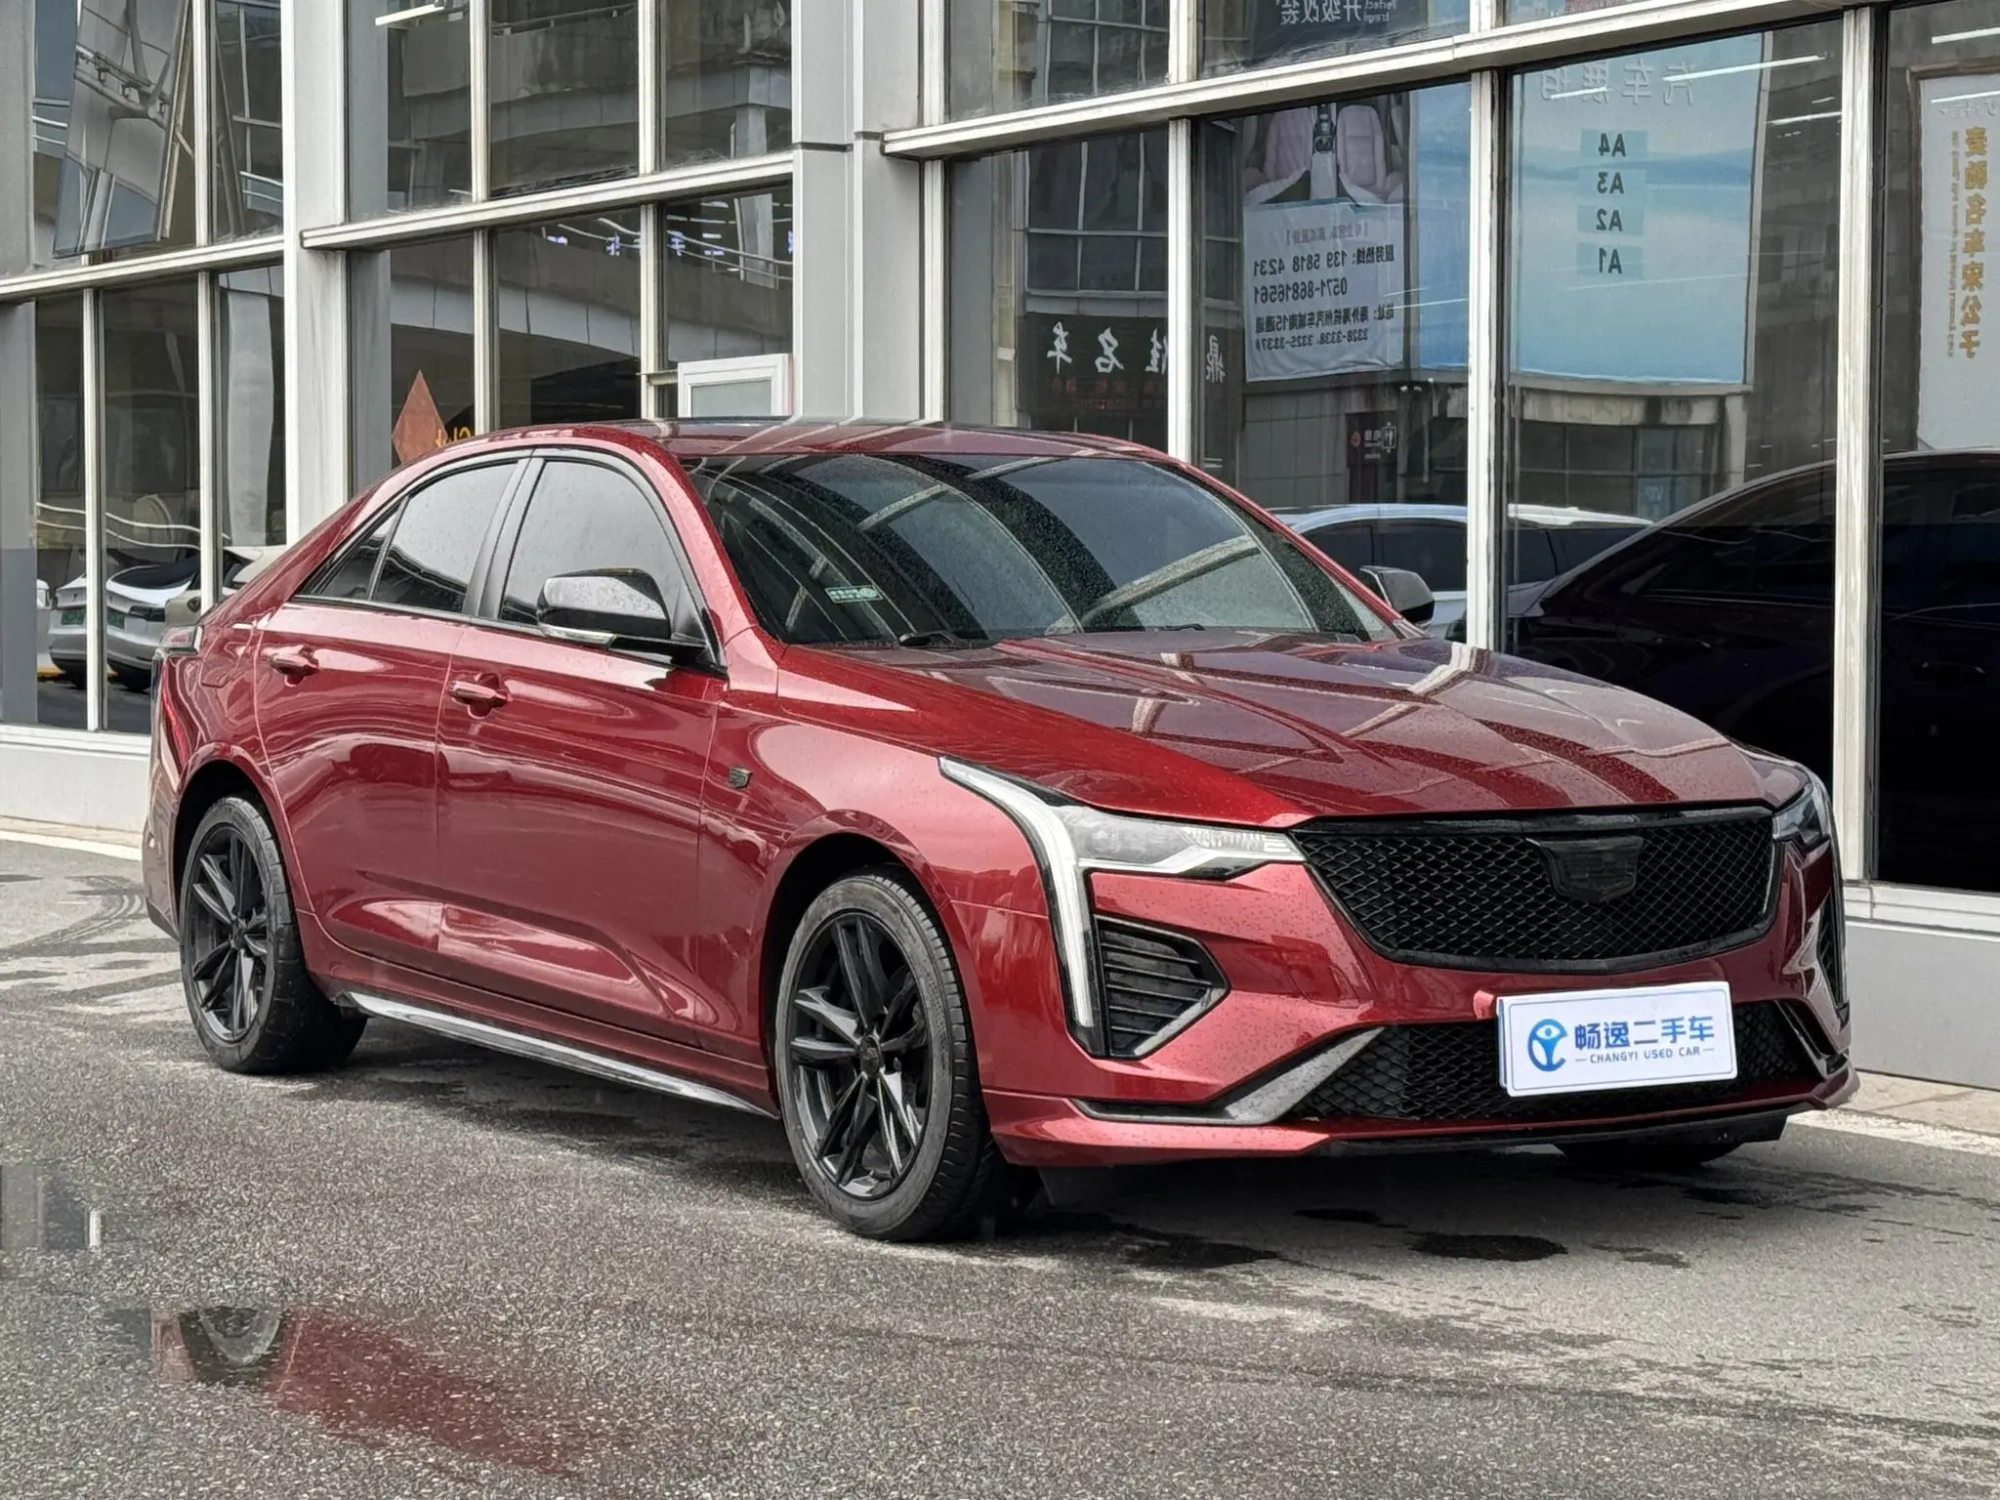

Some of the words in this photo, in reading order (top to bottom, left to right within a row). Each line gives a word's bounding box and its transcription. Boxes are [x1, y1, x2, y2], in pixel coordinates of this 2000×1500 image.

[1574, 1015, 1715, 1050] 畅逸二手车
[1589, 1051, 1639, 1064] CHANGYI
[1644, 1048, 1673, 1060] USED
[1678, 1046, 1700, 1057] CAR
